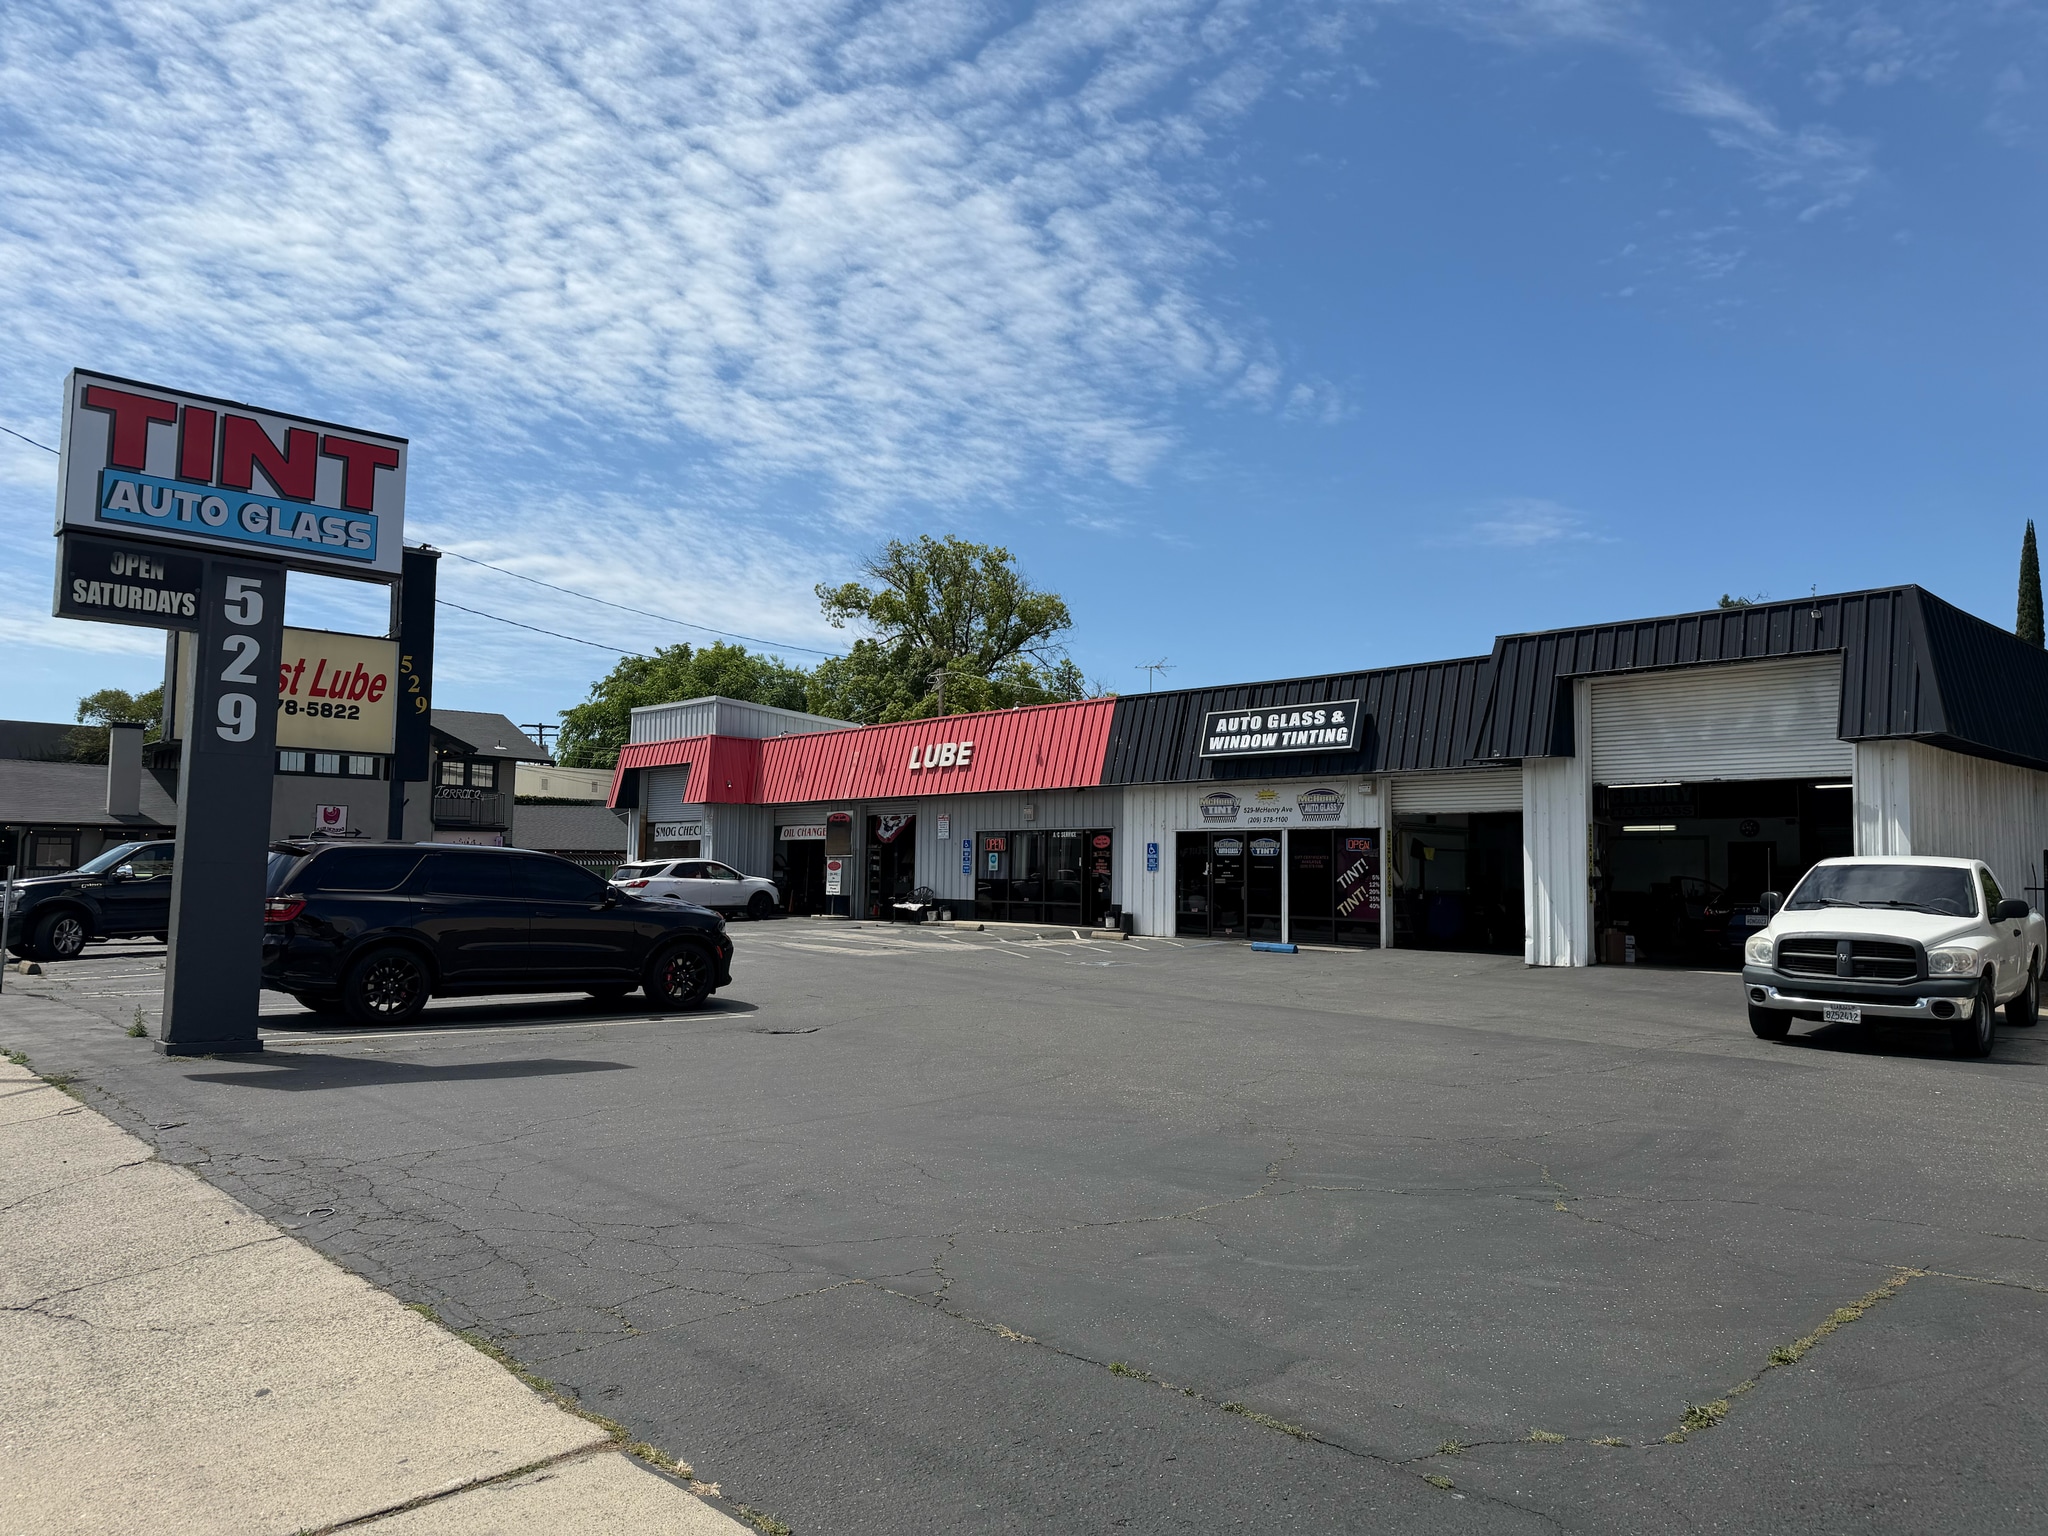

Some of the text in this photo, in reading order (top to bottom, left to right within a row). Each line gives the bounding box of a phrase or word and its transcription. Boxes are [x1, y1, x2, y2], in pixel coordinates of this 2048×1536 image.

[81, 383, 399, 512] TINT
[103, 477, 372, 551] AUTO GLASS
[110, 550, 165, 581] OPEN
[72, 578, 196, 617] SATURDAYS
[216, 575, 264, 743] 529
[278, 658, 388, 703] st Lube
[1215, 709, 1345, 733] AUTO GLASS &
[1209, 726, 1348, 751] WINDOW TINTING
[908, 740, 974, 770] LUBE
[1199, 797, 1241, 806] McHenry
[1207, 806, 1233, 814] TINT
[1297, 794, 1345, 803] McHenry
[1304, 802, 1338, 813] AUTO GLASS
[656, 826, 677, 837] SMOG
[783, 827, 827, 837] OIL CHANGE
[985, 838, 1005, 850] OPEN
[1347, 839, 1371, 850] OPEN
[1336, 857, 1369, 889] TINT!
[1336, 885, 1369, 917] TINT!
